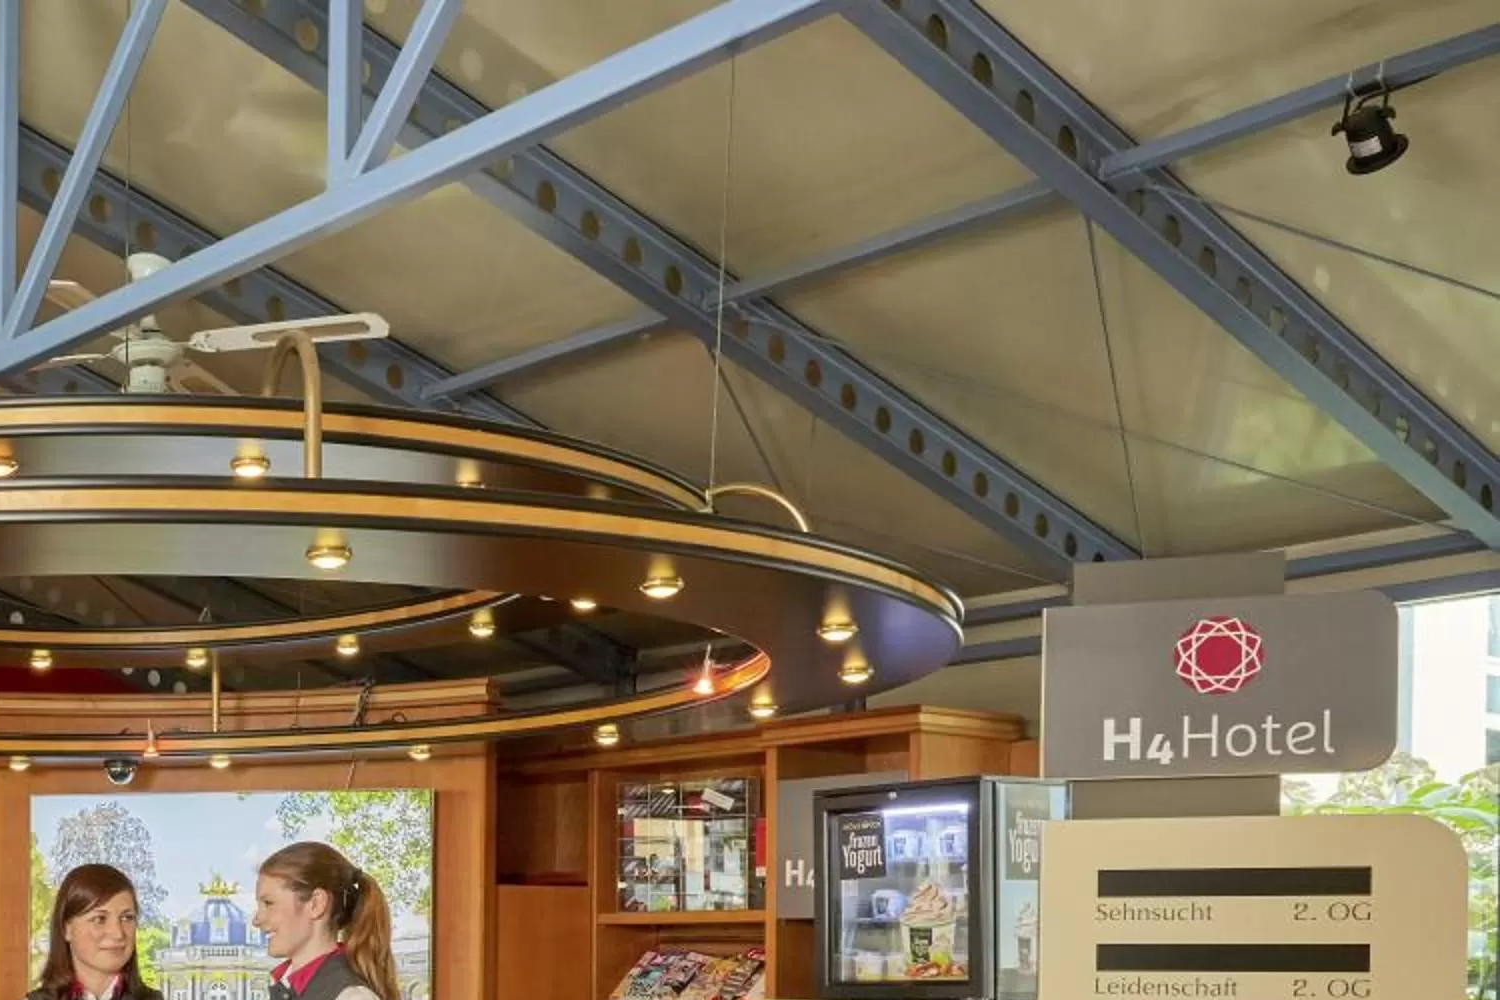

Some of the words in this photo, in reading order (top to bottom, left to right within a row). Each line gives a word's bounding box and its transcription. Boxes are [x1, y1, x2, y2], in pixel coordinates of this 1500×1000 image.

[842, 844, 884, 875] Yogurt
[1094, 902, 1213, 922] Sehnsucht
[1292, 902, 1317, 922] 2.
[1326, 901, 1372, 922] OG
[1094, 976, 1238, 998] Leidenschaft
[1292, 978, 1317, 998] 2.
[1326, 978, 1371, 999] OG
